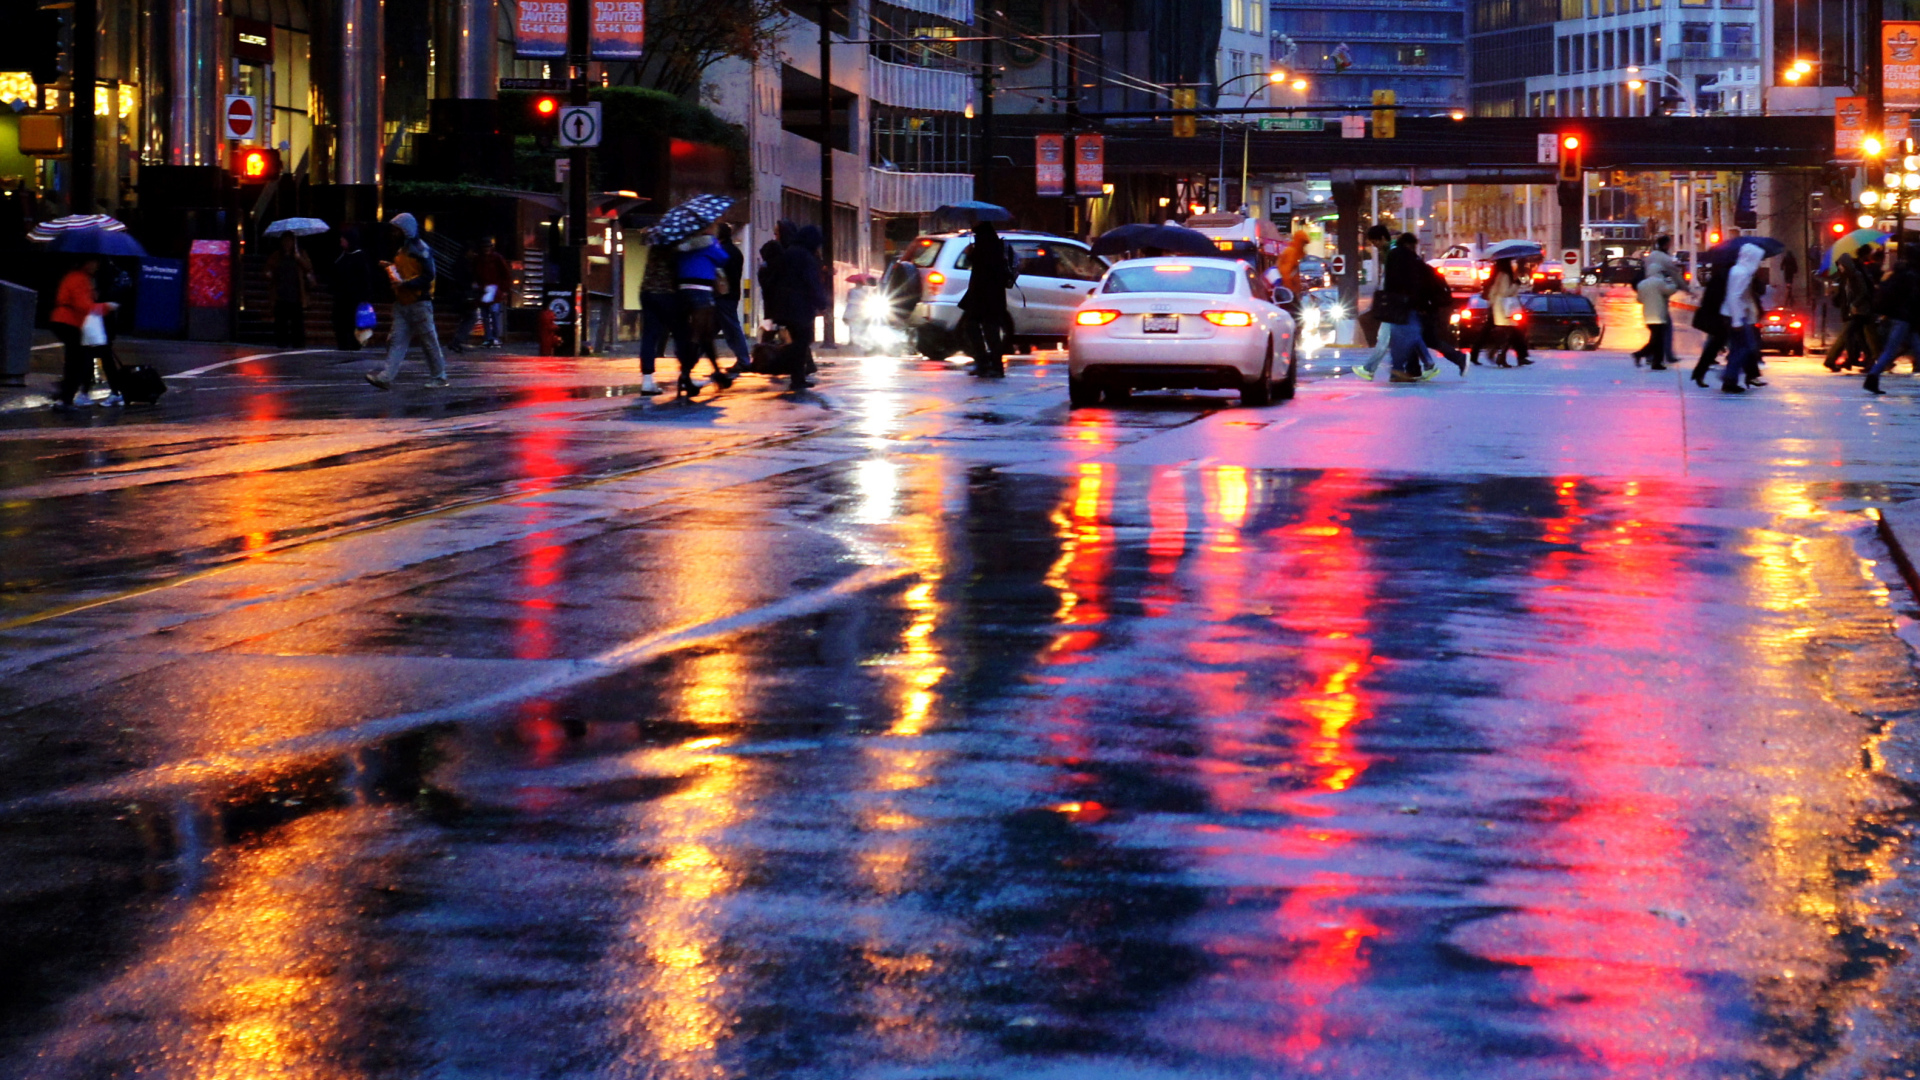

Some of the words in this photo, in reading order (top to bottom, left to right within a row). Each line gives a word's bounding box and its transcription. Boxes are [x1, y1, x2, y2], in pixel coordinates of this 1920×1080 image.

[1884, 64, 1904, 73] GREY
[1884, 72, 1920, 80] FESTIVAL
[1262, 119, 1306, 130] Granville
[1275, 197, 1287, 209] P
